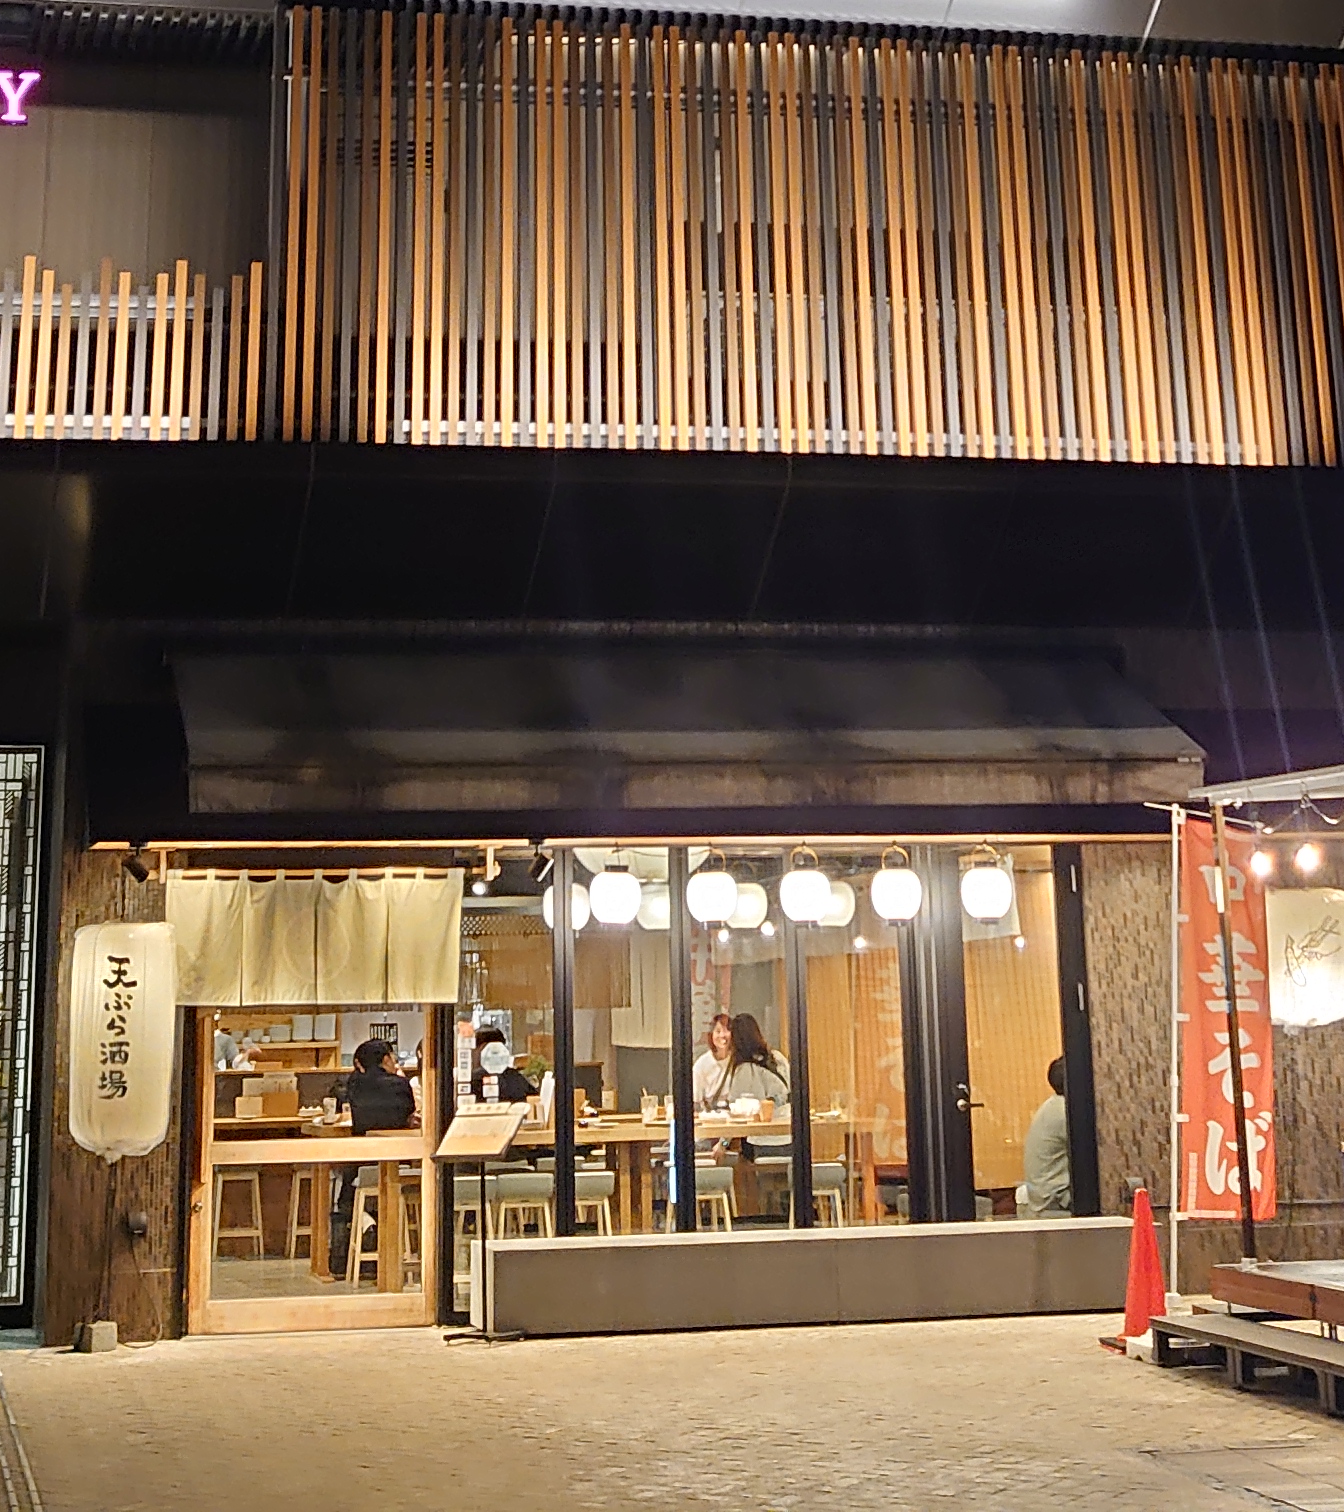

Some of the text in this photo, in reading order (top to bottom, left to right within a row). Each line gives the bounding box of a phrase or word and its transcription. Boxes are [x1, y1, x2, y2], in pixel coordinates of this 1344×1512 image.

[98, 955, 138, 1100] 天ぷら酒場
[1197, 848, 1273, 1196] 中華そば
